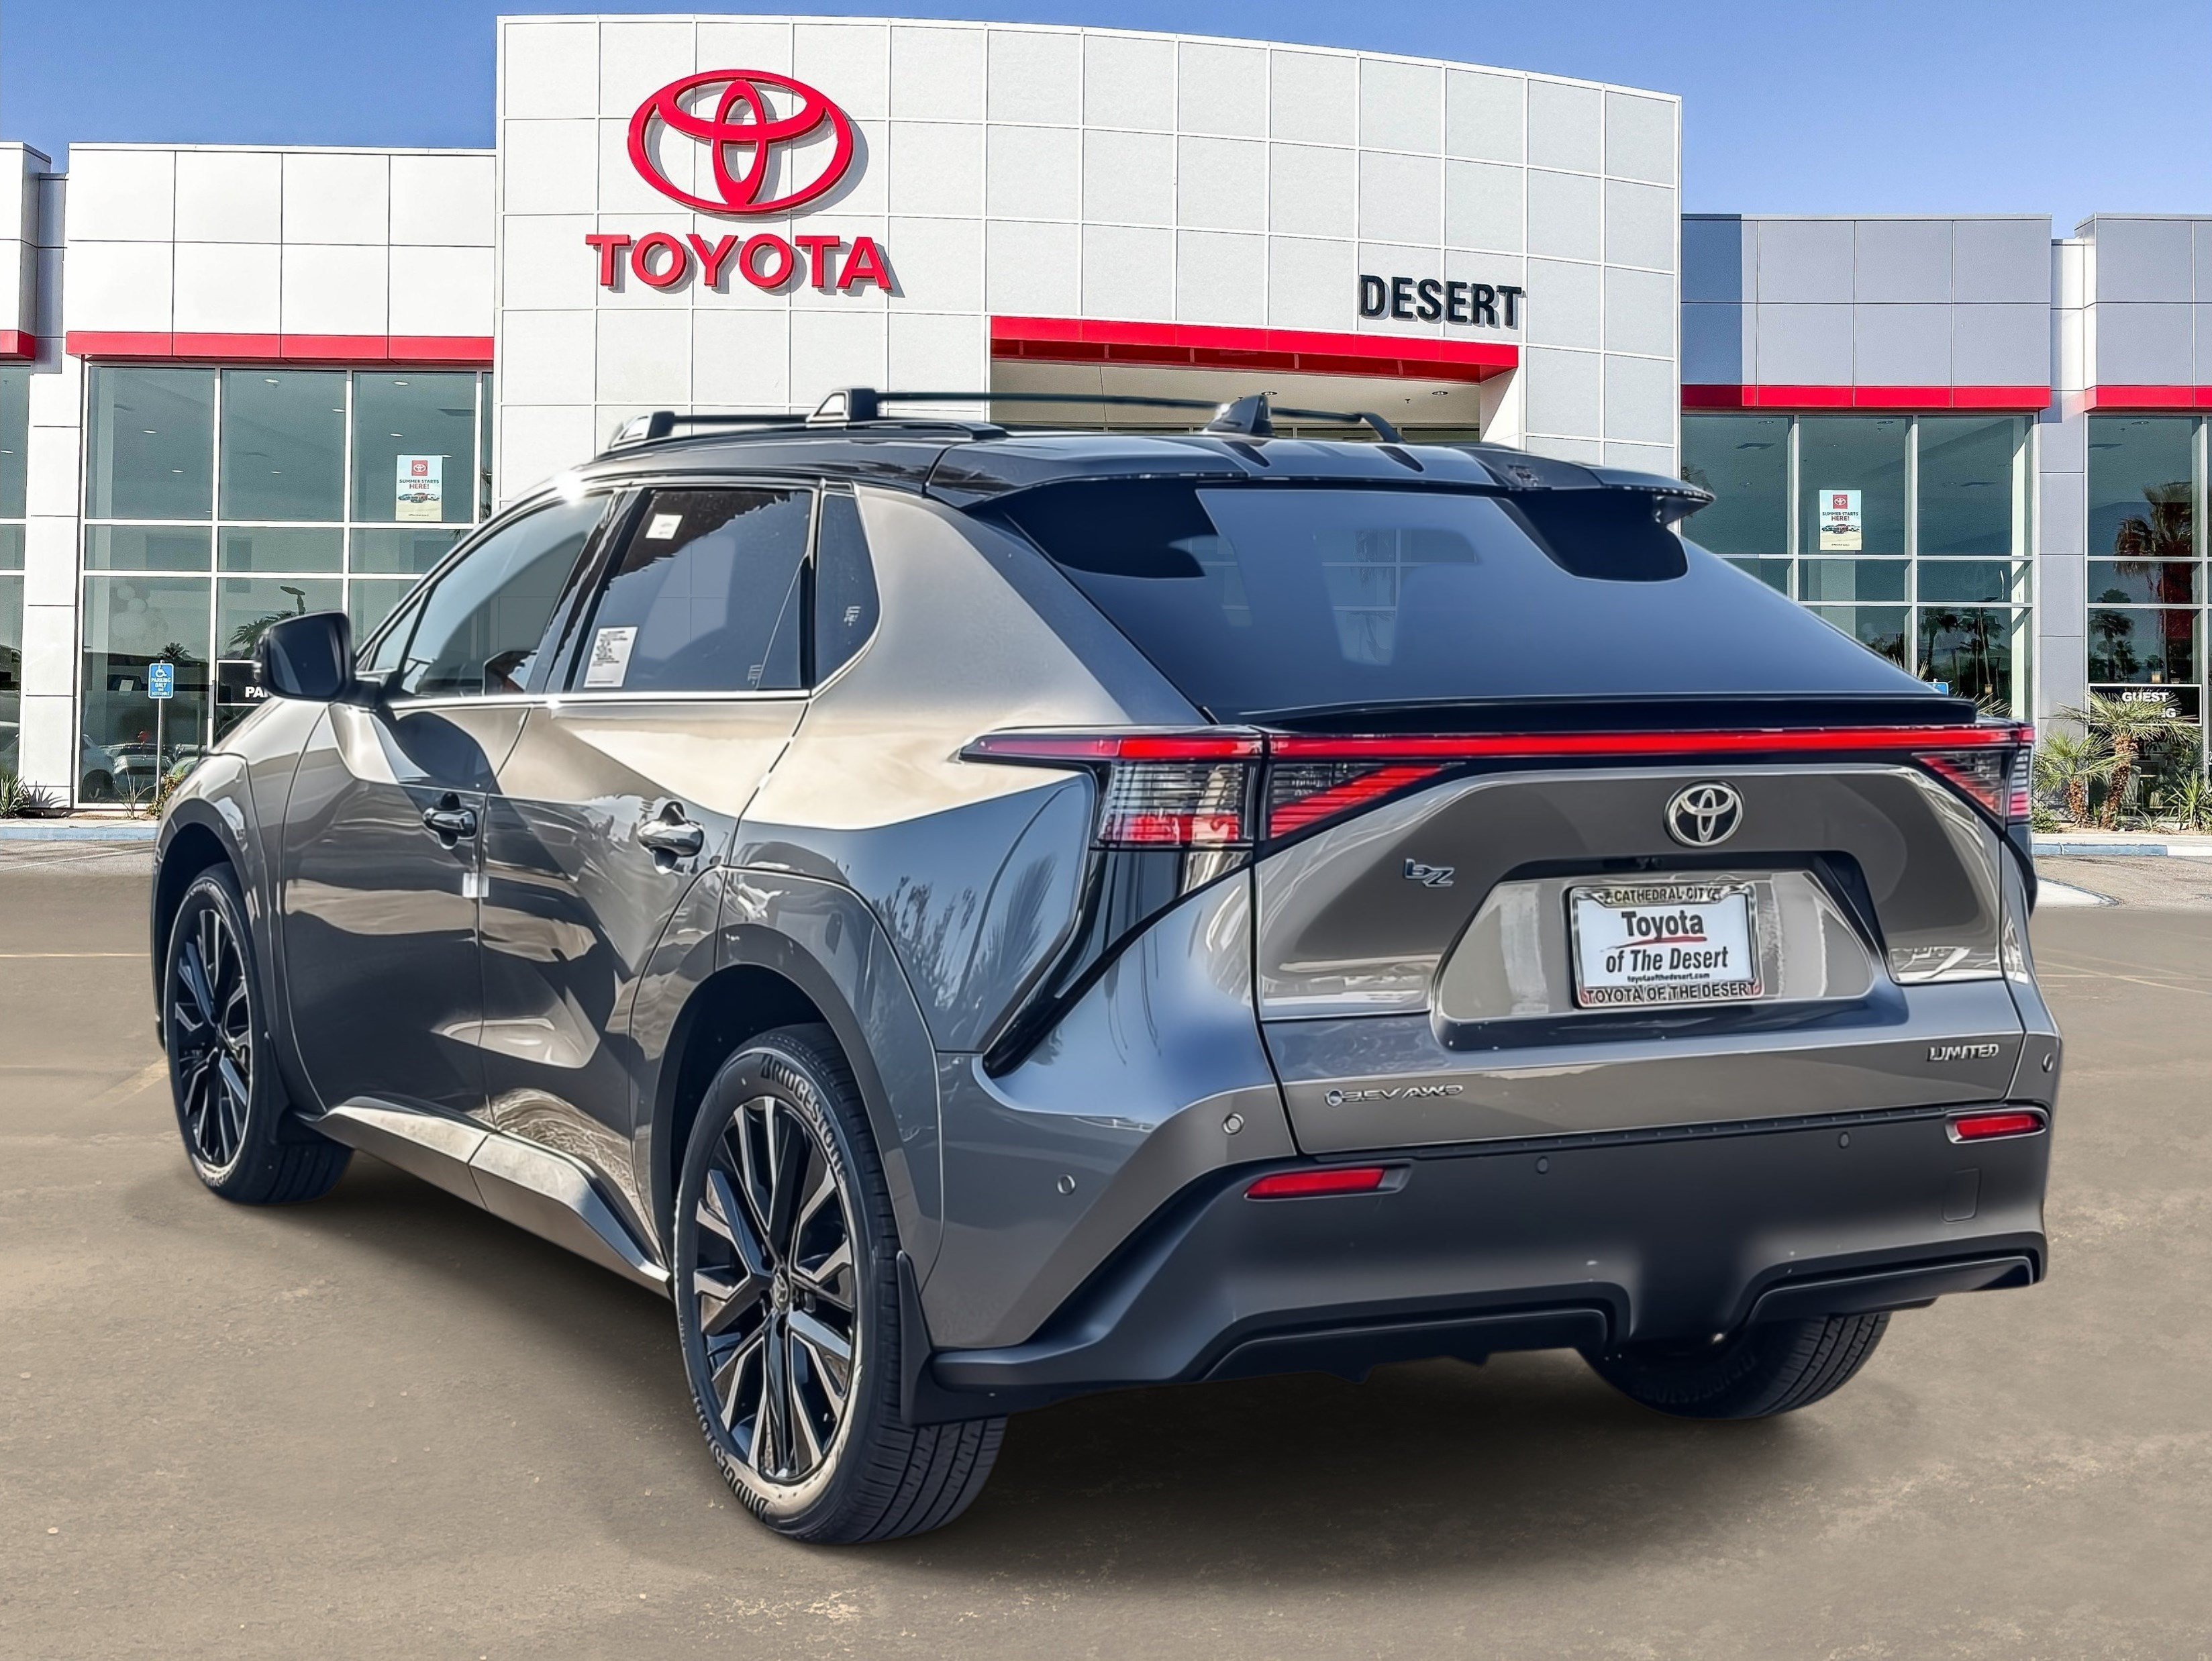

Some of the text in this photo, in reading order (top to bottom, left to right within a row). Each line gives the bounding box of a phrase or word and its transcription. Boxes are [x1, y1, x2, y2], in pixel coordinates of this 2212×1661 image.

[585, 232, 893, 291] TOYOTA
[1359, 274, 1522, 327] DESERT
[2122, 692, 2169, 703] GUEST
[1613, 886, 1711, 903] CATHEDRAL CITY
[1621, 909, 1704, 940] Toyota
[1606, 946, 1728, 973] of The Desert
[1627, 973, 1710, 984] toyotaofthedesert.com
[1586, 981, 1755, 1004] TOYOTA OF THE DESERT
[1927, 1044, 1999, 1061] LIMITED
[1401, 1083, 1464, 1099] AWD
